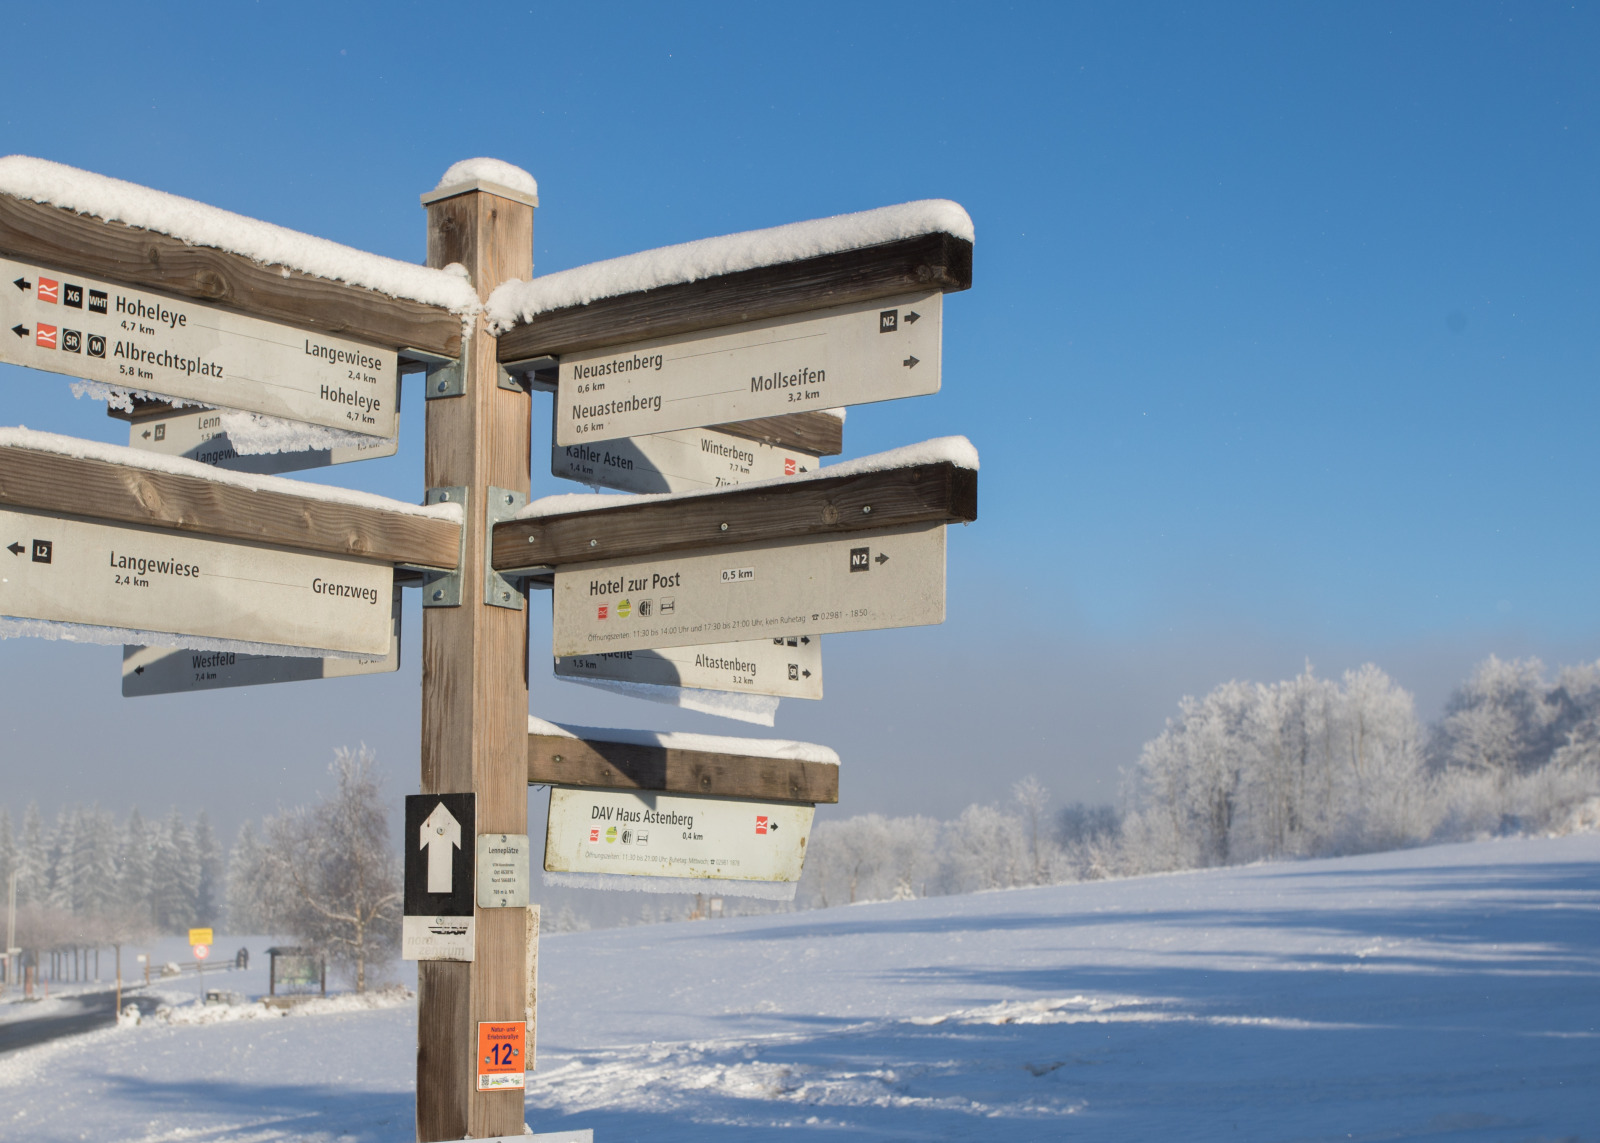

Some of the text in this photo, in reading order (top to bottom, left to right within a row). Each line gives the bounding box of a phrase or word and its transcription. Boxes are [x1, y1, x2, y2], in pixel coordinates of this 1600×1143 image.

[67, 290, 80, 302] X6
[89, 295, 107, 308] WHT
[116, 295, 187, 328] Hoheleye
[120, 320, 155, 336] 4,7 km
[882, 316, 895, 327] N2
[66, 335, 78, 347] SR
[91, 341, 102, 351] M
[113, 340, 224, 379] Albrechtsplatz
[305, 339, 382, 371] Langewiese
[119, 364, 154, 380] 5,8 km
[573, 354, 663, 381] Neuastenberg
[348, 370, 377, 384] 2,4 km
[751, 367, 826, 393] Mollseifen
[577, 382, 605, 394] 0,6 km
[320, 384, 381, 413] Hoheleye
[788, 390, 820, 403] 3,2 km
[572, 395, 662, 421] Neuastenberg
[346, 411, 375, 425] 4,7 km
[211, 432, 222, 440] km
[576, 423, 604, 435] 0,6 km
[566, 445, 633, 470] Kahler Asten
[701, 438, 754, 466] Winterberg
[570, 463, 594, 475] 1,4 km
[729, 463, 750, 474] 7,7 km
[36, 546, 48, 557] L2
[110, 551, 200, 578] Langewiese
[115, 575, 149, 587] 2,4 km
[722, 569, 753, 581] 0,5 km
[312, 578, 378, 604] Grenzweg
[590, 572, 681, 596] Hotel zur Post
[678, 625, 689, 633] Uhr
[691, 624, 702, 632] und
[704, 622, 720, 631] 17:30
[722, 621, 731, 629] bis
[765, 617, 779, 625] kein
[780, 614, 806, 624] Ruhetag
[820, 611, 842, 620] 02981
[192, 653, 235, 669] Westfeld
[573, 659, 597, 669] 1,5 km
[695, 654, 756, 676] Altastenberg
[195, 672, 217, 681] 7,4 km
[733, 676, 754, 685] 3,2 km
[591, 805, 693, 830] DAV Haus Astenberg
[682, 832, 703, 841] 0,4 km
[491, 1043, 512, 1065] 12
